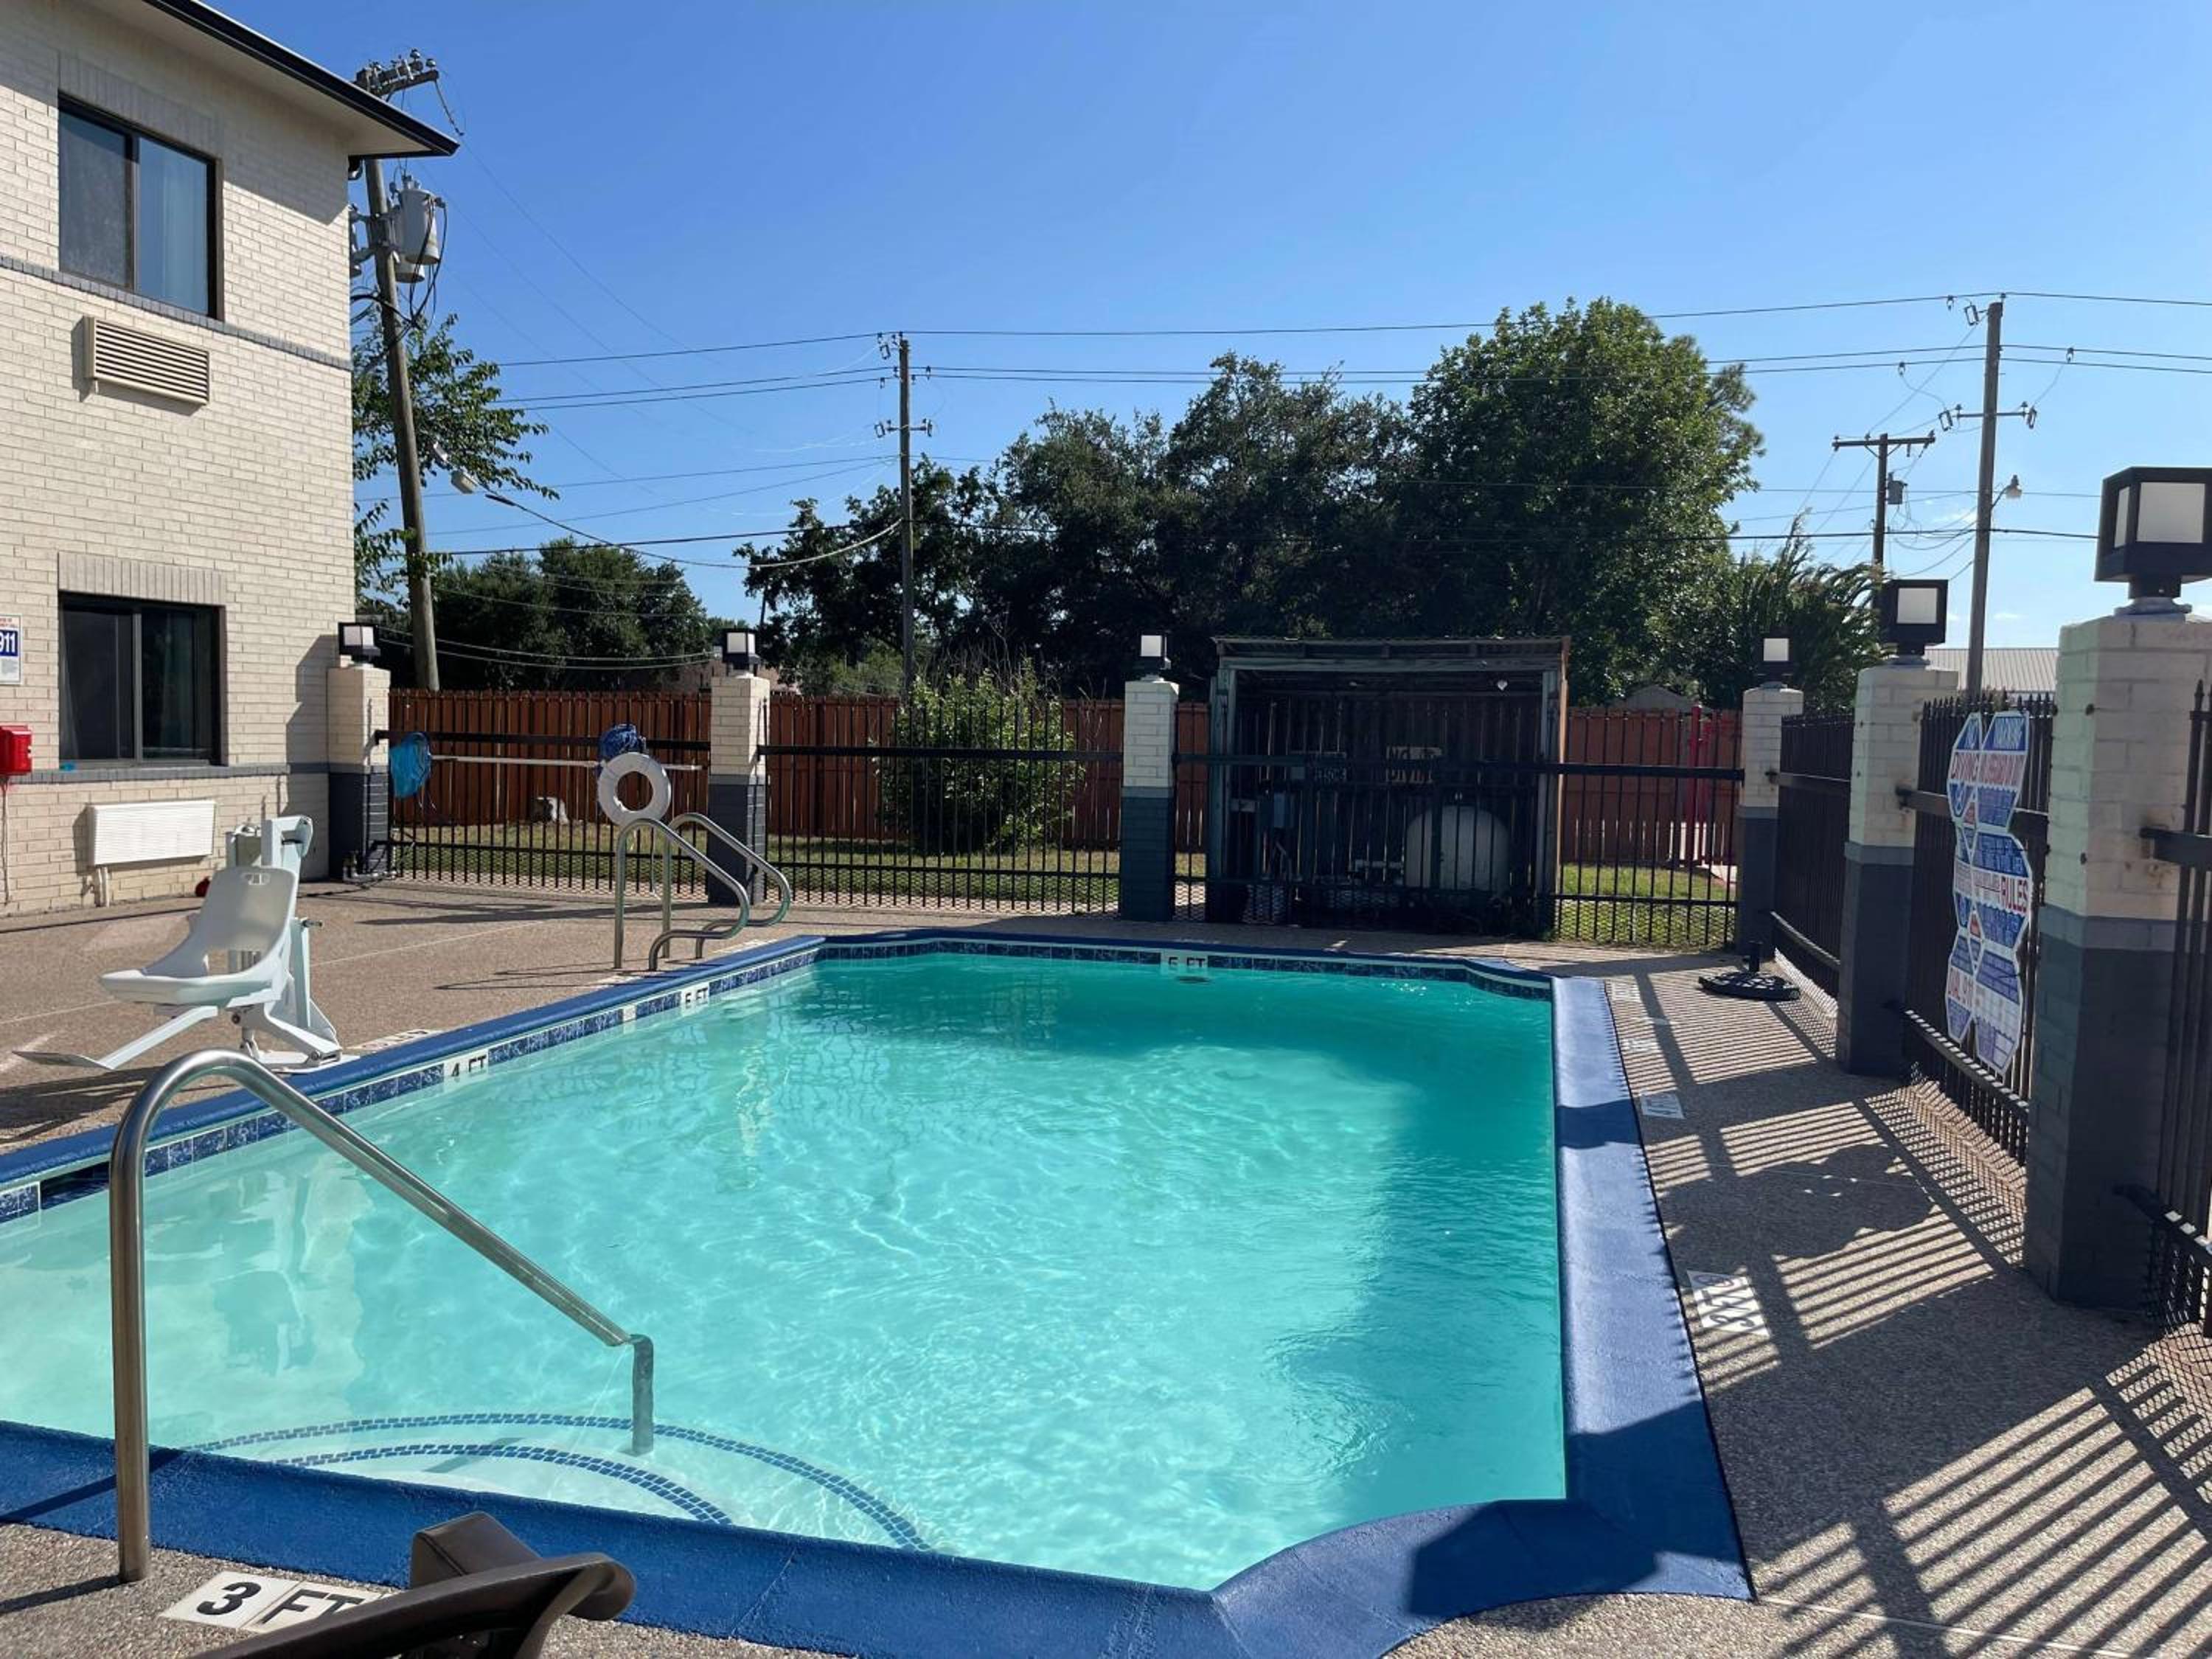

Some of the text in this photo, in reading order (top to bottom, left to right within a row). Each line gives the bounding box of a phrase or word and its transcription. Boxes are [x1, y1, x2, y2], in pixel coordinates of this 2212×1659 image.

[2000, 874, 2028, 912] RULES
[196, 1582, 365, 1624] 3 FT
